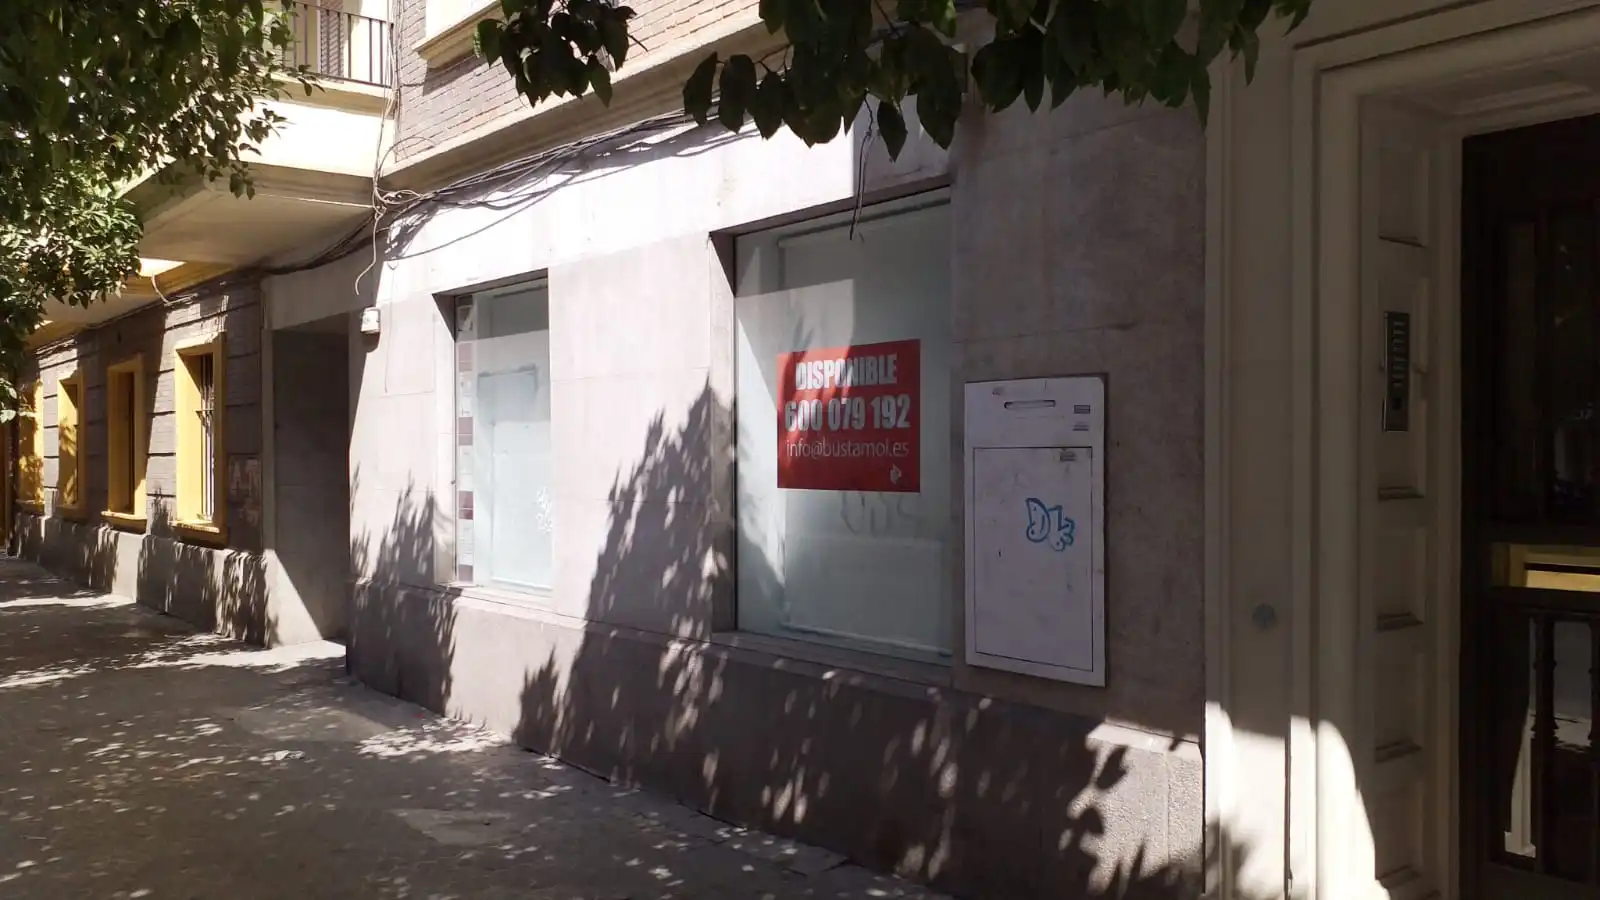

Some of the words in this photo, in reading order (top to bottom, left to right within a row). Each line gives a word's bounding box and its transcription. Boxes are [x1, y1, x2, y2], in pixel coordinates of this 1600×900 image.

[796, 353, 898, 390] DISPONIBLE
[785, 399, 823, 432] 600
[828, 395, 866, 431] 079
[870, 393, 911, 429] 192
[786, 437, 909, 459] info@bustamol.es
